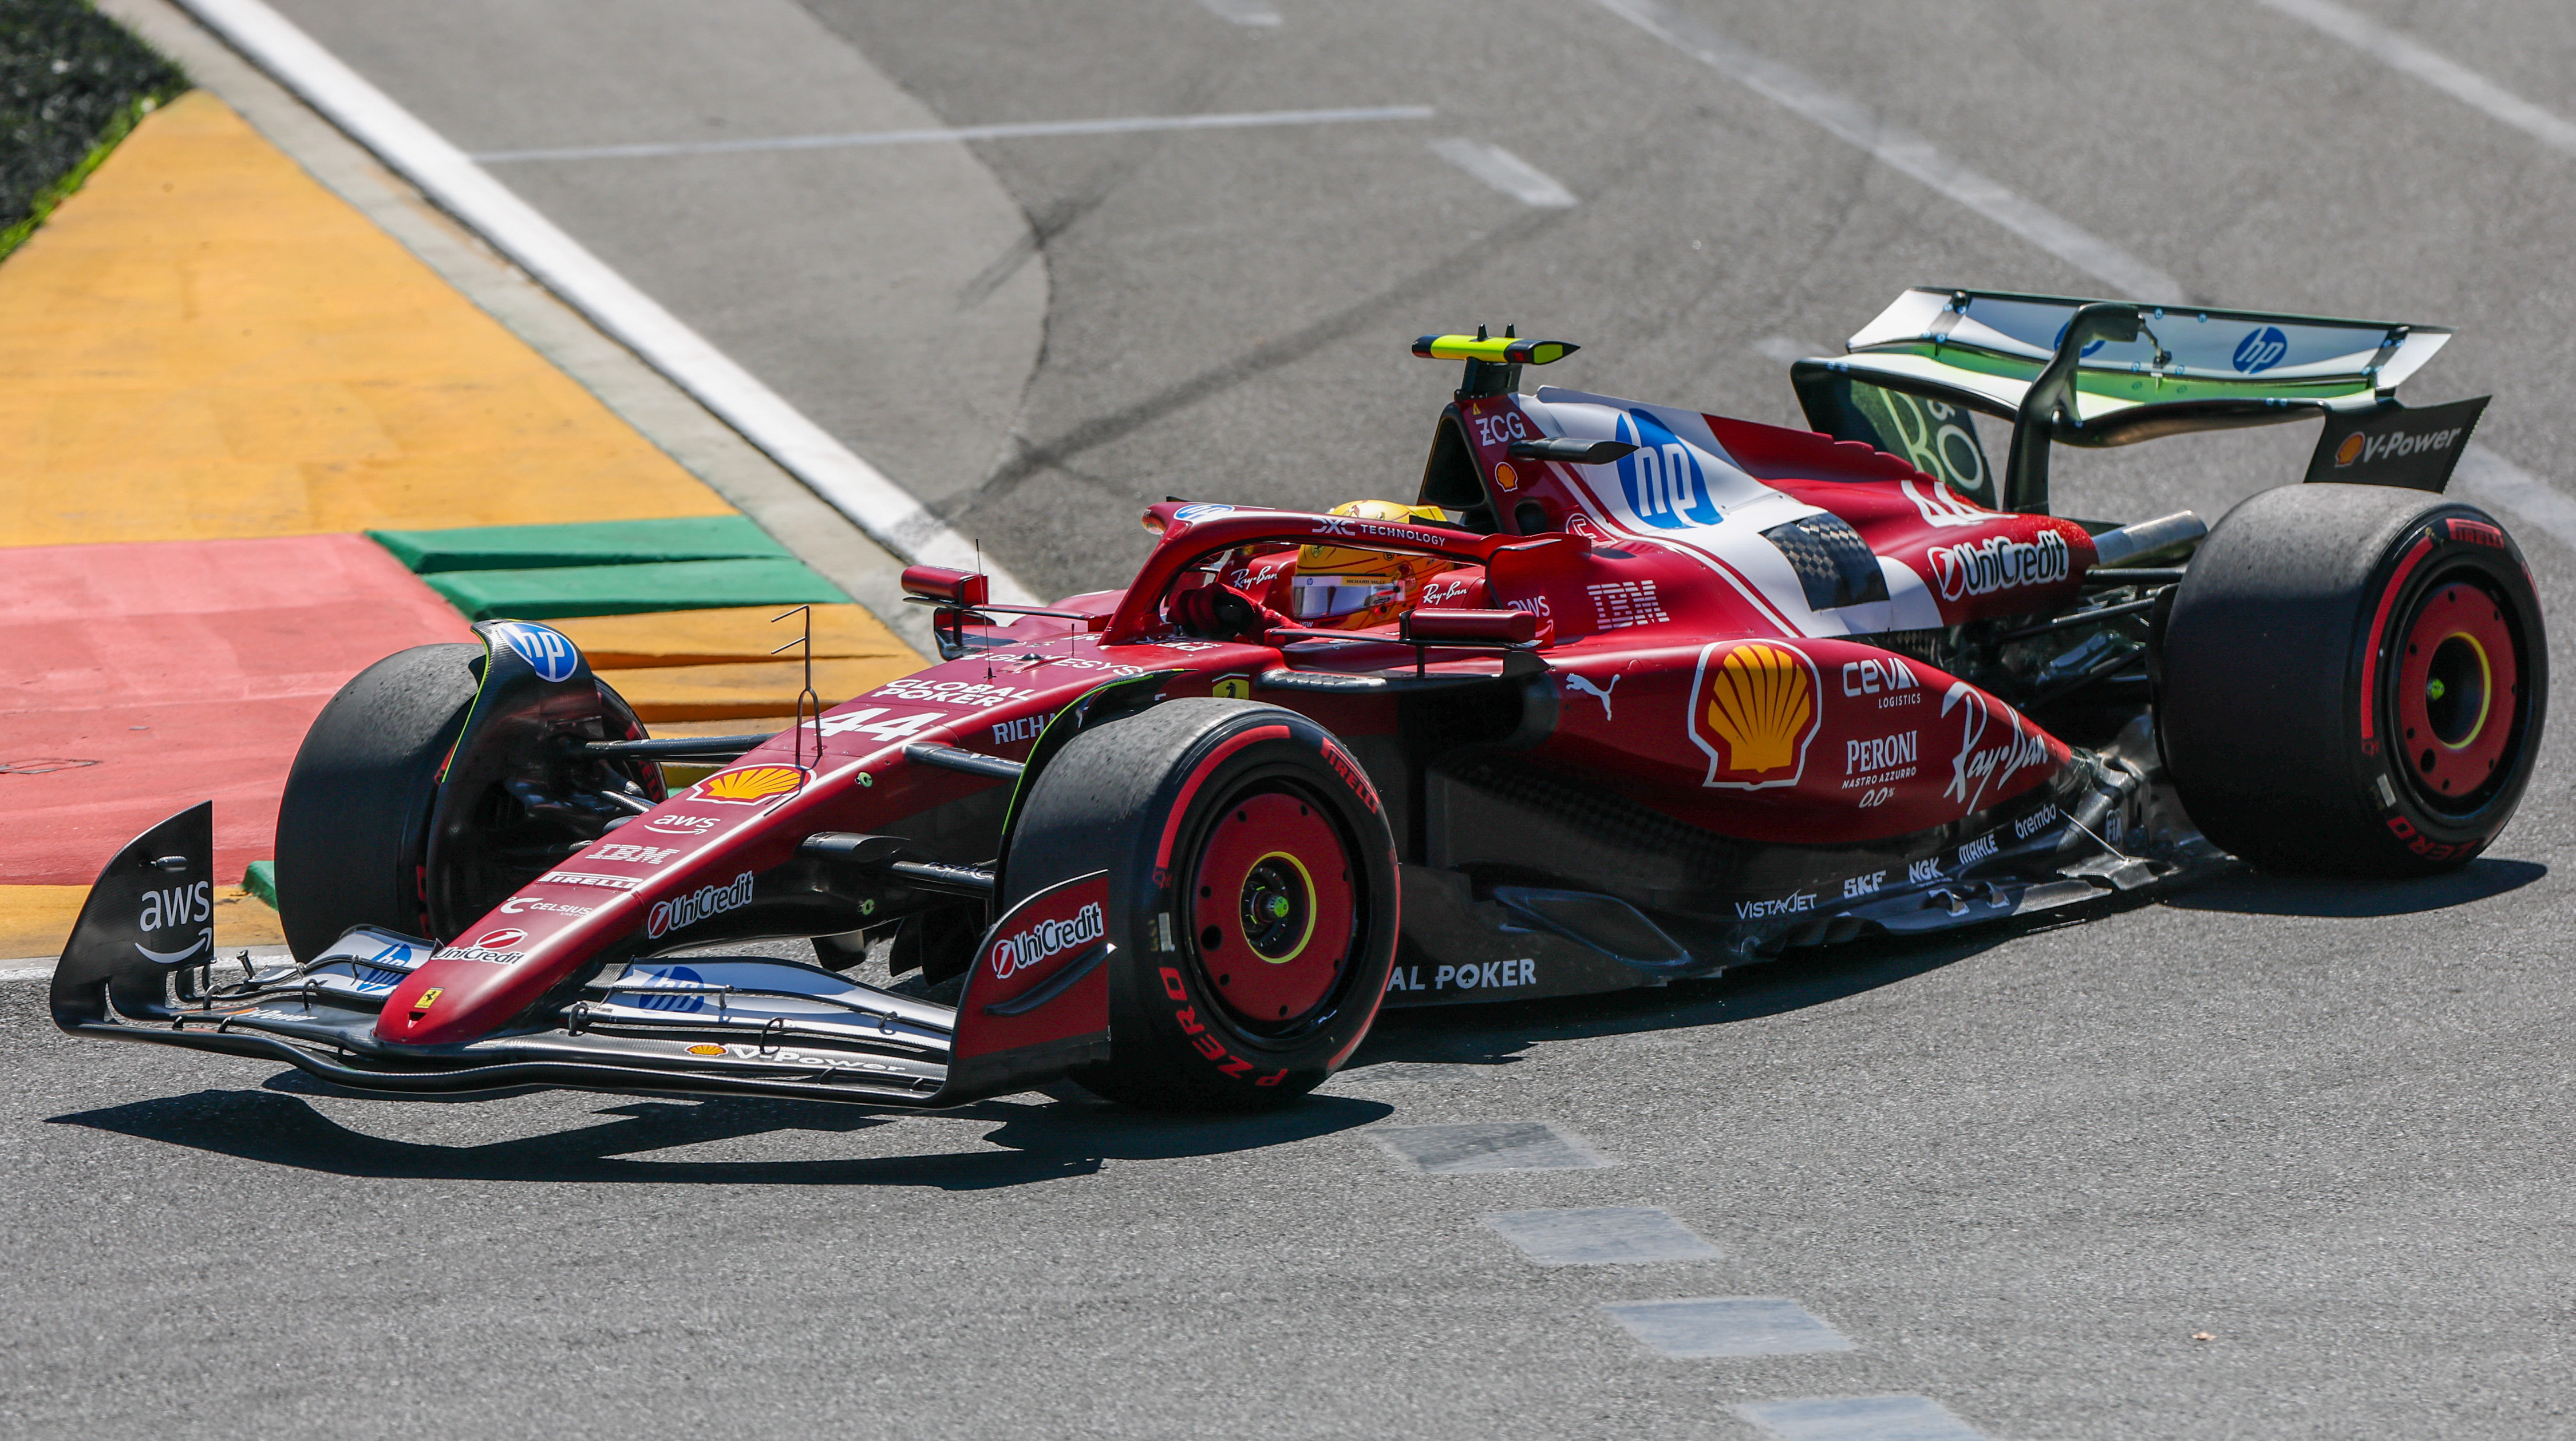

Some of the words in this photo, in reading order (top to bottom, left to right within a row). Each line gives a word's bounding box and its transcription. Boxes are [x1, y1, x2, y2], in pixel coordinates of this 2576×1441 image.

[2237, 327, 2285, 373] hp
[1475, 411, 1527, 446] ZCG
[2363, 427, 2462, 462] V-Power
[1629, 406, 1699, 529] hp
[1312, 517, 1356, 536] DXC
[1361, 524, 1445, 547] TECHNOLOGY
[2446, 518, 2505, 548] PIRELLI
[1957, 531, 2067, 591] UniCredit
[1586, 580, 1670, 630] IBM
[511, 623, 565, 679] hp
[871, 688, 1005, 707] POKER
[886, 679, 1035, 701] GLOBAL
[1879, 693, 1921, 709] LOGISTICS
[801, 707, 948, 742] 44
[1846, 730, 1917, 775] PERONI
[1321, 737, 1380, 814] PIRELLI
[1842, 775, 1877, 789] NASTRO
[1879, 766, 1917, 783] AZZURRO
[653, 814, 721, 828] aws
[2016, 802, 2056, 840] brembo
[584, 844, 681, 865] IBM
[1958, 834, 1998, 865] MAHLE
[538, 871, 644, 889] PIRELLI
[1844, 870, 1886, 899] SKF
[1909, 856, 1944, 884] NGK
[140, 881, 210, 932] aws
[531, 902, 594, 915] CELSIUS
[670, 872, 752, 928] UniCredit
[1012, 903, 1102, 968] UniCredit
[433, 948, 525, 965] UniCredit
[1436, 958, 1536, 989] POKER
[1159, 967, 1254, 1079] ZERO
[732, 1047, 906, 1071] V-Power
